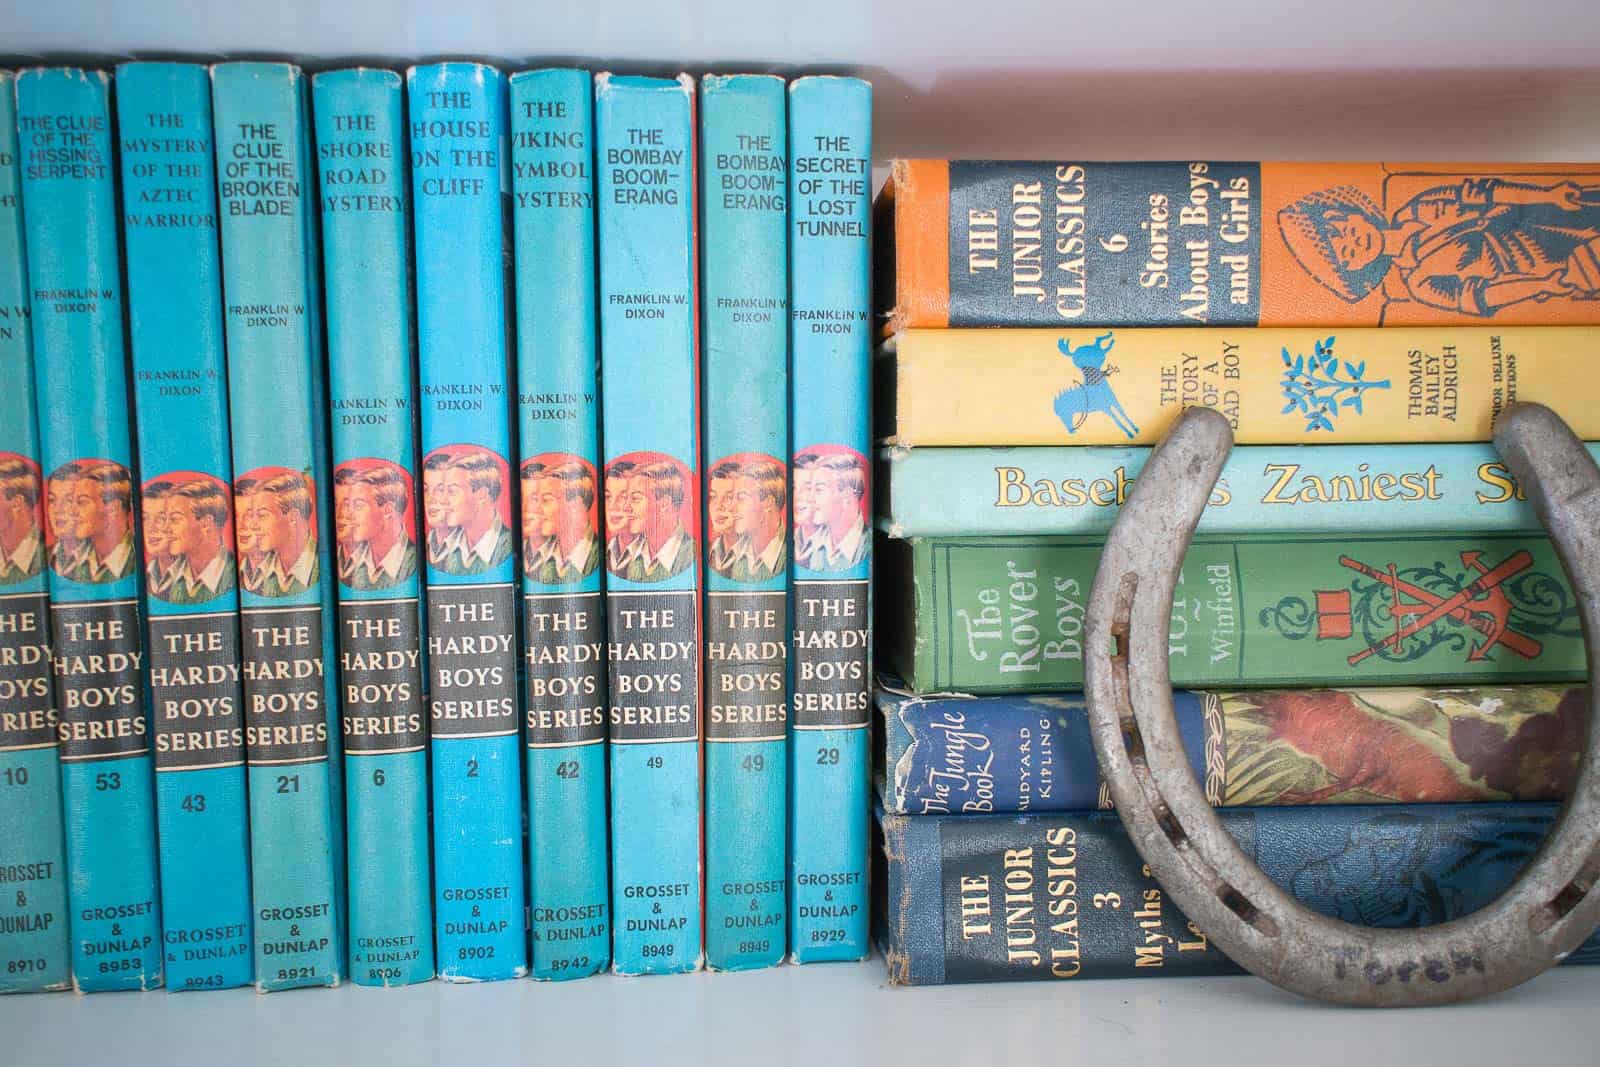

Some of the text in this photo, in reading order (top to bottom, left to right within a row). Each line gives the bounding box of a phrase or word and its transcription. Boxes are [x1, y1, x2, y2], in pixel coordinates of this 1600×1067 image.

[426, 92, 472, 109] THE
[522, 102, 567, 118] THE
[56, 115, 104, 130] CLUE
[146, 113, 184, 128] THE
[333, 115, 376, 131] THE
[412, 121, 490, 138] HOUSE
[32, 132, 95, 146] OF THE
[238, 124, 276, 140] THE
[627, 129, 663, 145] THE
[232, 144, 283, 159] CLUE
[320, 142, 390, 158] SHORE
[736, 135, 771, 151] THE
[814, 136, 850, 152] THE
[451, 150, 497, 168] THE
[608, 149, 683, 165] BOMBAY
[717, 155, 786, 170] BOMBAY
[796, 158, 867, 174] SECRET
[27, 165, 107, 180] SERPENT
[164, 164, 201, 177] THE
[226, 163, 293, 178] OF THE
[326, 169, 386, 185] ROAD
[222, 182, 300, 198] BROKEN
[423, 179, 484, 196] CLIFF
[798, 180, 865, 196] OF THE
[614, 189, 678, 205] ERANG
[723, 194, 784, 211] ERANG
[229, 200, 292, 216] BLADE
[808, 200, 856, 215] LOST
[126, 214, 215, 228] WARRIOR
[797, 221, 867, 237] TUNNEL
[968, 208, 998, 274] THE
[1012, 181, 1046, 303] JUNIOR
[1056, 165, 1085, 318] CLASSICS
[1100, 233, 1128, 253] 6
[1139, 193, 1169, 289] Stories
[1180, 161, 1220, 322] About Boys
[1219, 176, 1249, 305] and Girls
[34, 289, 98, 300] FRANKLIN
[609, 294, 670, 305] FRANKLIN
[718, 298, 776, 308] FRANKLIN
[54, 303, 97, 313] DIXON
[229, 304, 289, 315] FRANKLIN
[625, 308, 665, 319] DIXON
[792, 310, 855, 320] FRANKLIN
[247, 317, 287, 327] DIXON
[733, 312, 771, 323] DIXON
[812, 323, 851, 334] DIXON
[1222, 341, 1240, 382] BOY
[1490, 335, 1501, 382] DELUXE
[1160, 365, 1177, 406] THE
[1203, 361, 1218, 408] OF A
[1408, 349, 1422, 420] THOMAS
[1425, 353, 1441, 417] BAILEY
[1442, 345, 1457, 423] ALDRICH
[1506, 353, 1516, 405] DITIONS
[159, 386, 201, 396] DIXON
[437, 400, 482, 411] DIXON
[532, 409, 577, 420] DIXON
[342, 415, 387, 425] DIXON
[1261, 463, 1443, 506] Zaniest
[438, 602, 494, 622] THE
[803, 598, 855, 617] THE
[1207, 564, 1234, 664] Winfield
[534, 612, 588, 632] THE
[620, 610, 674, 629] THE
[724, 610, 775, 629] THE
[957, 588, 1000, 661] The
[1000, 561, 1039, 673] Rover
[1044, 577, 1086, 660] Boys
[64, 621, 124, 641] THE
[252, 627, 310, 647] THE
[347, 618, 401, 638] THE
[164, 632, 222, 653] THE
[428, 634, 513, 655] HARDY
[793, 629, 869, 650] HARDY
[526, 643, 602, 665] HARDY
[608, 642, 693, 661] HARDY
[708, 642, 787, 660] HARDY
[54, 651, 143, 676] HARDY
[243, 659, 324, 680] HARDY
[341, 650, 419, 672] HARDY
[151, 665, 240, 687] HARDY
[439, 667, 503, 687] BOYS
[801, 661, 862, 681] BOYS
[533, 676, 596, 697] BOYS
[619, 673, 682, 693] BOYS
[722, 673, 781, 693] BOYS
[66, 685, 135, 708] BOYS
[253, 692, 318, 713] BOYS
[348, 683, 410, 704] BOYS
[794, 692, 867, 712] SERIES
[165, 697, 233, 720] BOYS
[432, 698, 513, 720] SERIES
[610, 705, 690, 724] SERIES
[711, 704, 787, 724] SERIES
[344, 714, 421, 735] SERIES
[528, 707, 603, 729] SERIES
[58, 716, 146, 741] SERIES
[247, 723, 327, 746] SERIES
[155, 729, 243, 752] SERIES
[646, 757, 663, 769] 49
[742, 754, 765, 772] 49
[816, 748, 840, 765] 29
[921, 712, 990, 814] The Jungle
[1038, 718, 1051, 798] KIPLING
[5, 768, 28, 786] 10
[373, 769, 385, 786] 6
[467, 760, 479, 777] 2
[556, 762, 579, 779] 42
[96, 772, 121, 791] 53
[277, 775, 300, 793] 21
[963, 750, 994, 813] Book
[182, 795, 206, 812] 43
[723, 880, 785, 895] GROSSET
[797, 872, 860, 886] GROSSET
[443, 887, 510, 900] GROSSET
[624, 884, 690, 898] GROSSET
[961, 874, 991, 940] THE
[1004, 847, 1041, 966] JUNIOR
[1047, 827, 1081, 977] CLASSICS
[1094, 892, 1121, 909] 3
[81, 902, 152, 921] GROSSET
[260, 904, 329, 921] GROSSET
[534, 904, 605, 922] GROSSET
[725, 913, 782, 928] DUNLAP
[800, 905, 858, 918] DUNLAP
[445, 920, 508, 935] DUNLAP
[547, 924, 605, 941] DUNLAP
[627, 917, 687, 931] DUNLAP
[1134, 889, 1173, 968] Myths
[165, 924, 247, 944] GROSSET
[358, 936, 415, 947] GROSSET
[812, 930, 846, 942] 8929
[85, 936, 152, 956] DUNLAP
[264, 938, 328, 955] DUNLAP
[459, 947, 495, 960] 8902
[642, 945, 674, 957] 8949
[740, 940, 770, 953] 8949
[8, 958, 47, 974] 8910
[99, 959, 142, 974] 8953
[278, 967, 316, 979] 8921
[551, 957, 589, 971] 8942
